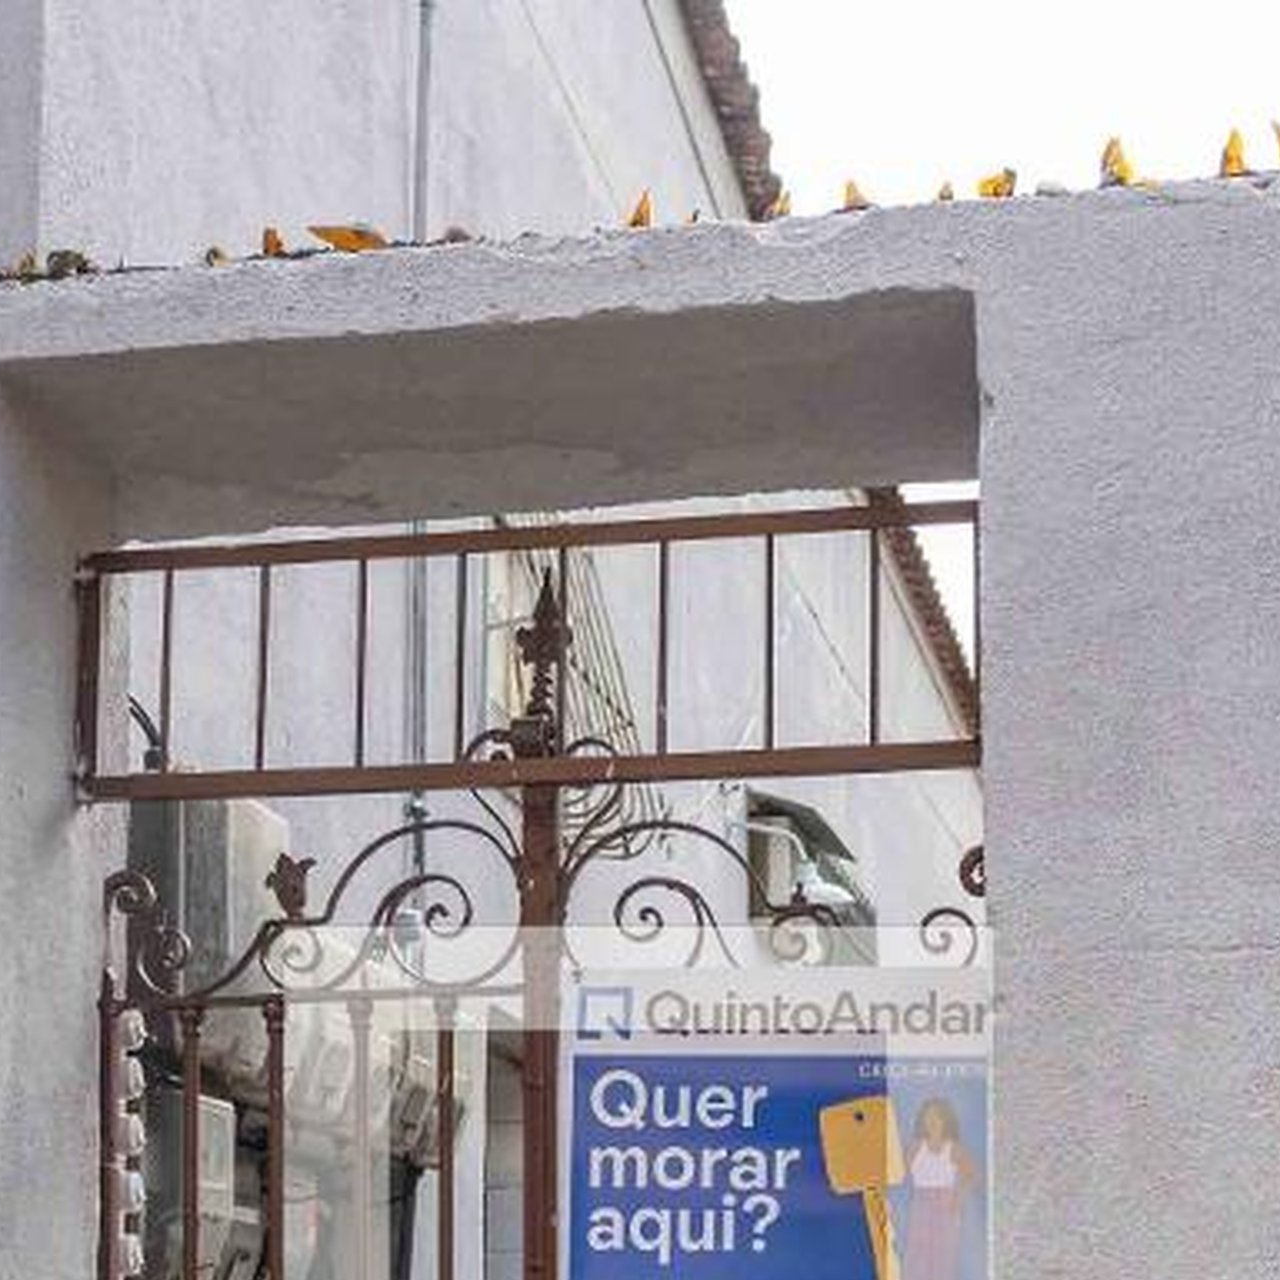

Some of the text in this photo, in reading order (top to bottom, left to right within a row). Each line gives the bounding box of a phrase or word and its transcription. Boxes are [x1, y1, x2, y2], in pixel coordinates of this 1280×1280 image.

[645, 989, 993, 1038] QuintoAndar
[589, 1068, 769, 1130] Quer
[587, 1142, 801, 1190] morar
[586, 1194, 781, 1265] aqui?
